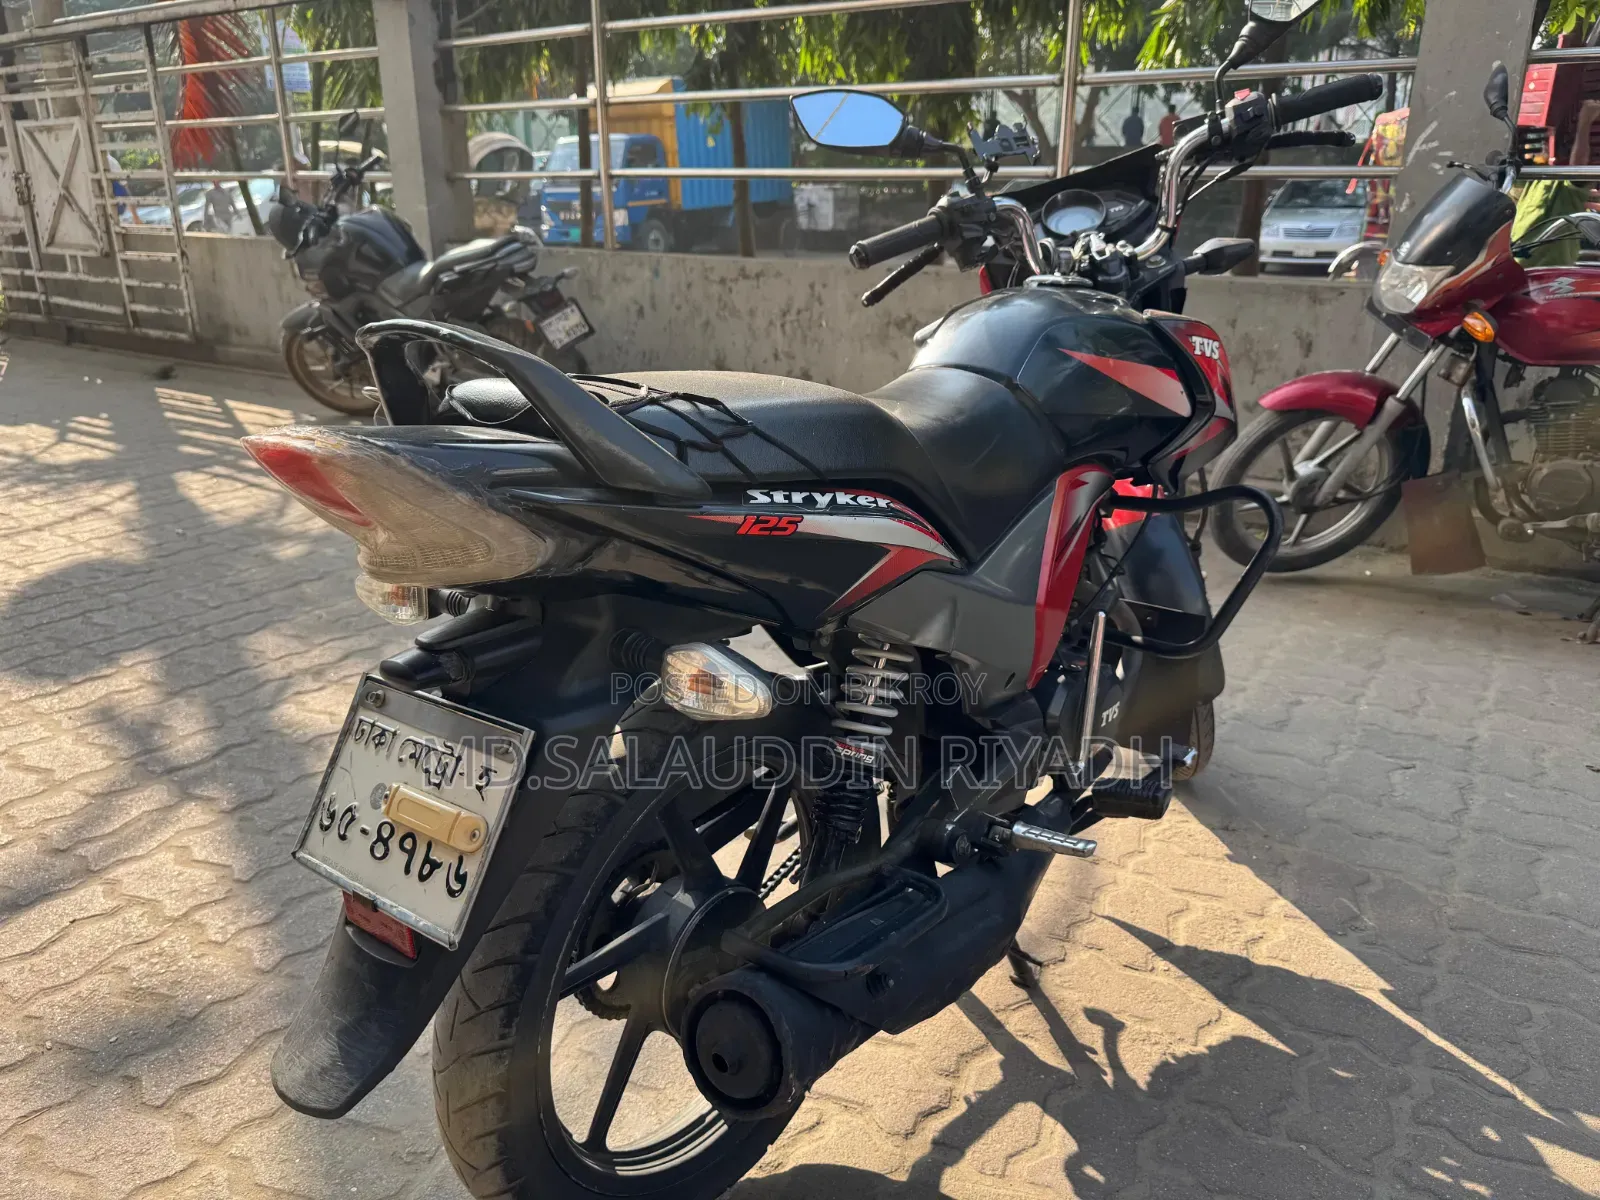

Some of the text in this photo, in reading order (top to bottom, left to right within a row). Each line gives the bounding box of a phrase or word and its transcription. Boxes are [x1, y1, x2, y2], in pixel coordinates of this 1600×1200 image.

[1191, 336, 1220, 360] TVS
[746, 489, 892, 508] Stryker
[736, 515, 803, 536] 125
[1101, 701, 1120, 727] TVS
[354, 715, 400, 753] ঢাকা
